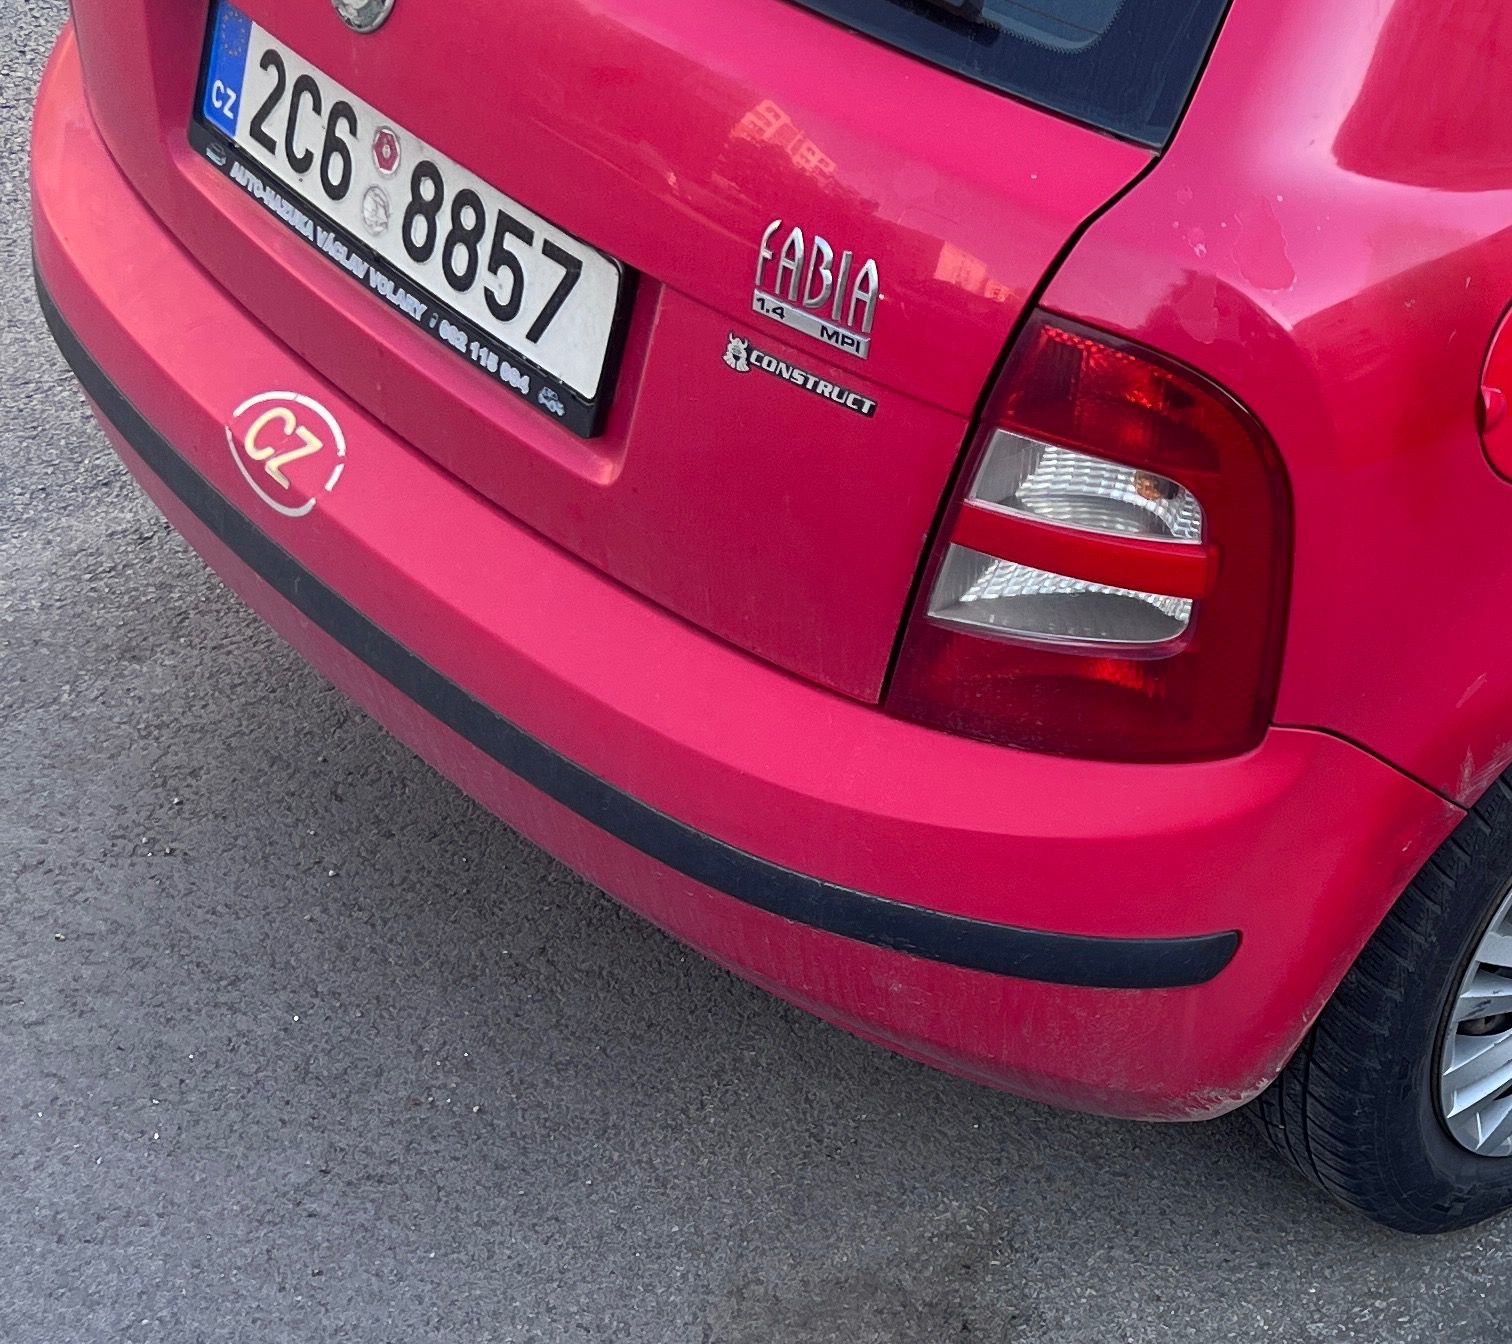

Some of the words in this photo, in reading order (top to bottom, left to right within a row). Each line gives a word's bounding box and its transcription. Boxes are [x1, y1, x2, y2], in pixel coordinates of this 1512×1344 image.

[211, 79, 237, 120] CZ
[249, 49, 358, 201] 2C6
[402, 160, 583, 344] 8857
[755, 219, 878, 334] FABIA
[756, 297, 786, 320] 1.4
[820, 325, 861, 355] MPI
[750, 349, 876, 415] CONSTRUCT
[244, 407, 323, 490] CZ
